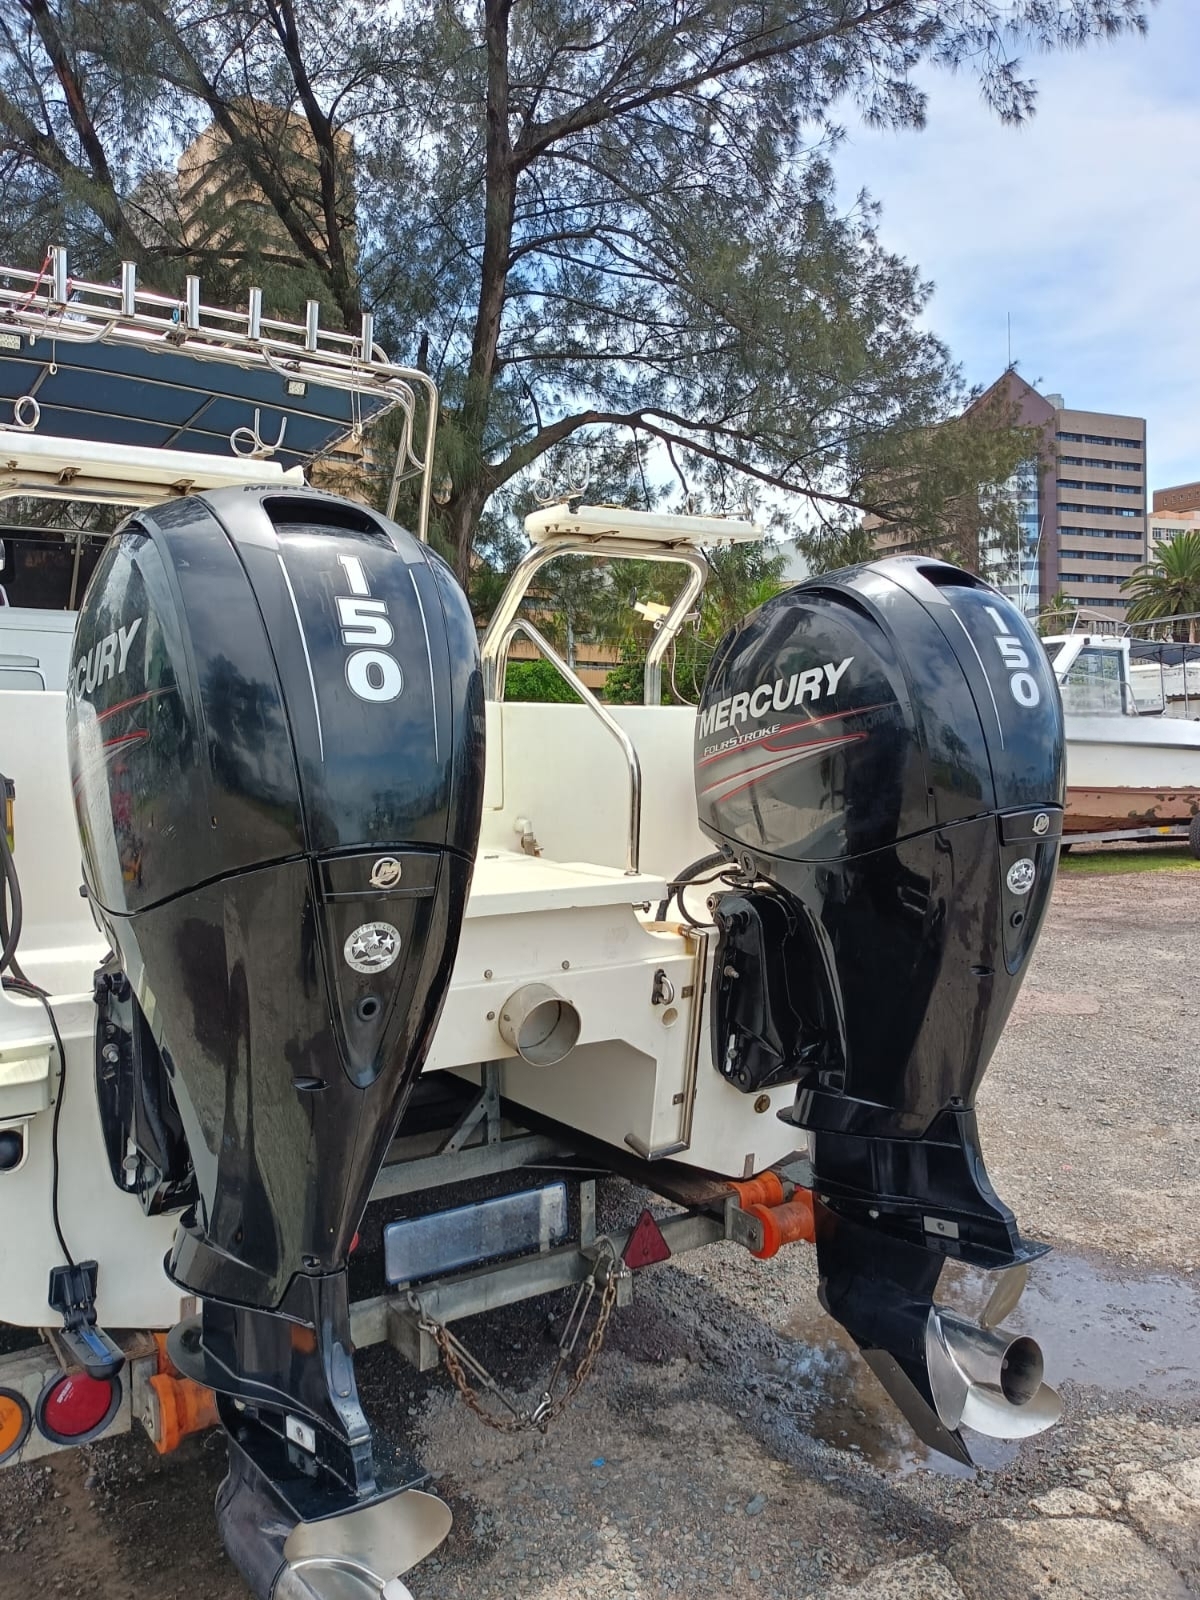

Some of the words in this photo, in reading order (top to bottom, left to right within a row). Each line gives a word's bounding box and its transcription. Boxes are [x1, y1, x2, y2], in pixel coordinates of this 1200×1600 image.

[334, 553, 404, 703] 150
[983, 606, 1040, 708] 150
[699, 656, 855, 740] MERCURY
